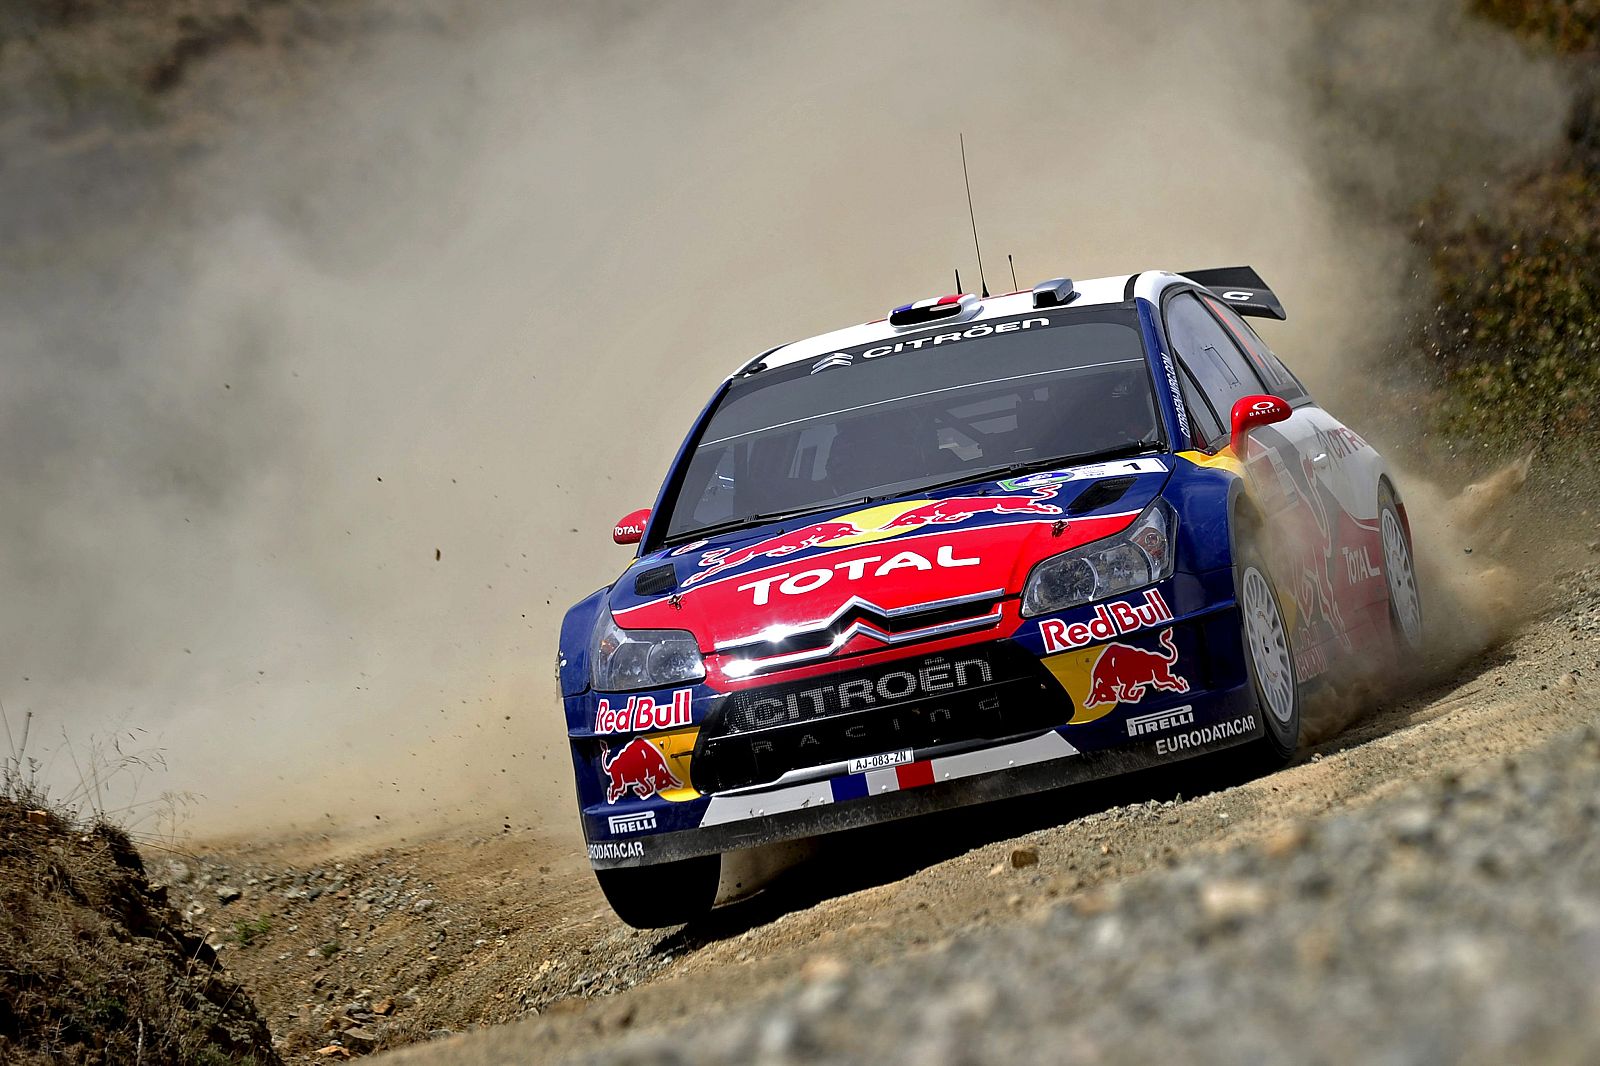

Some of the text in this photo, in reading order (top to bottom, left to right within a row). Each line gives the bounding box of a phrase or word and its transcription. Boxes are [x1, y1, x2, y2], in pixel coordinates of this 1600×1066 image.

[1123, 462, 1142, 471] 1
[614, 525, 642, 536] TOTAL
[737, 545, 981, 605] TOTAL
[1342, 545, 1380, 585] TOTAL
[1039, 587, 1175, 654] Red Bull
[594, 688, 693, 735] Red Bull
[1126, 704, 1195, 737] PIRELLI
[1155, 715, 1256, 755] EURODATACAR
[856, 750, 906, 770] AJ-083-ZN
[608, 810, 657, 834] PIRELLI
